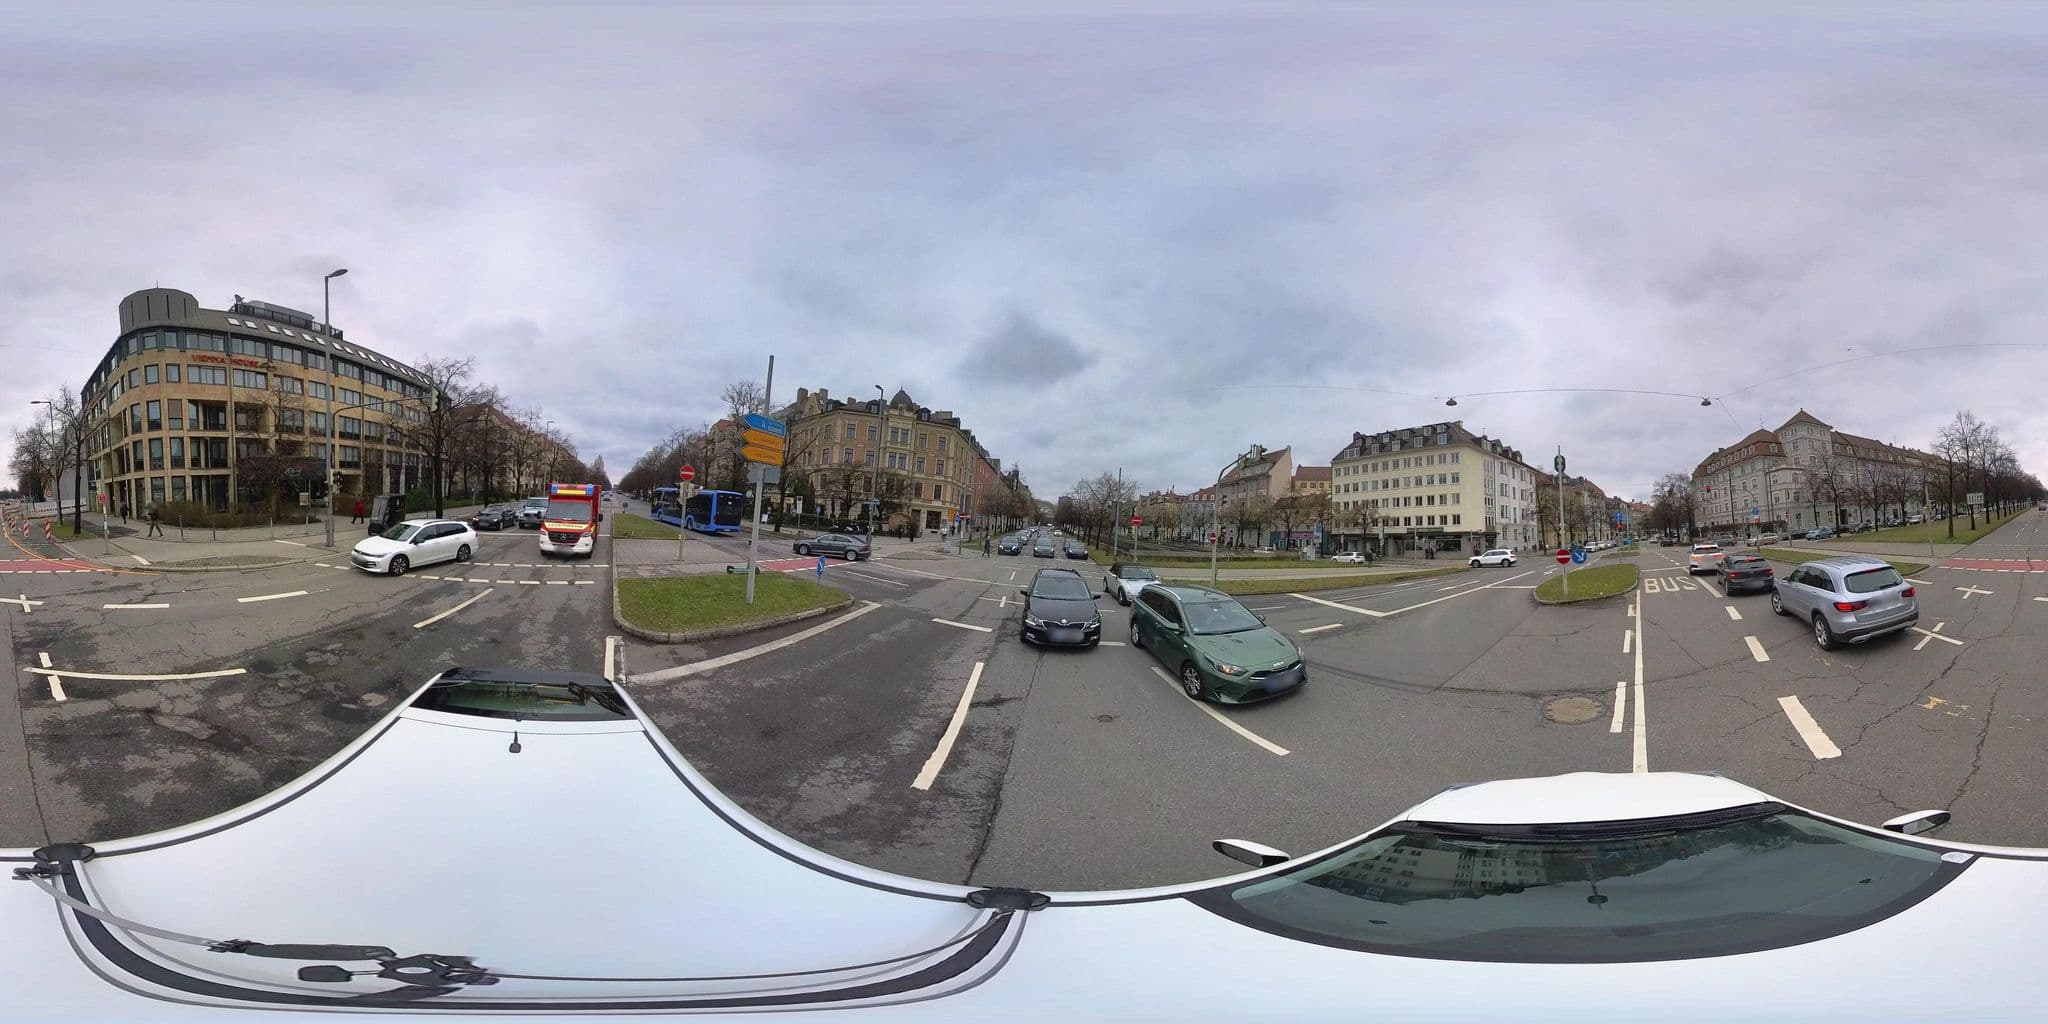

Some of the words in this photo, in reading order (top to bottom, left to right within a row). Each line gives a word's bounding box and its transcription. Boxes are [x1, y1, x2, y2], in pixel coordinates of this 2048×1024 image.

[191, 354, 226, 364] VIENNA
[231, 357, 259, 368] HOUSE
[1644, 576, 1697, 593] BUS
